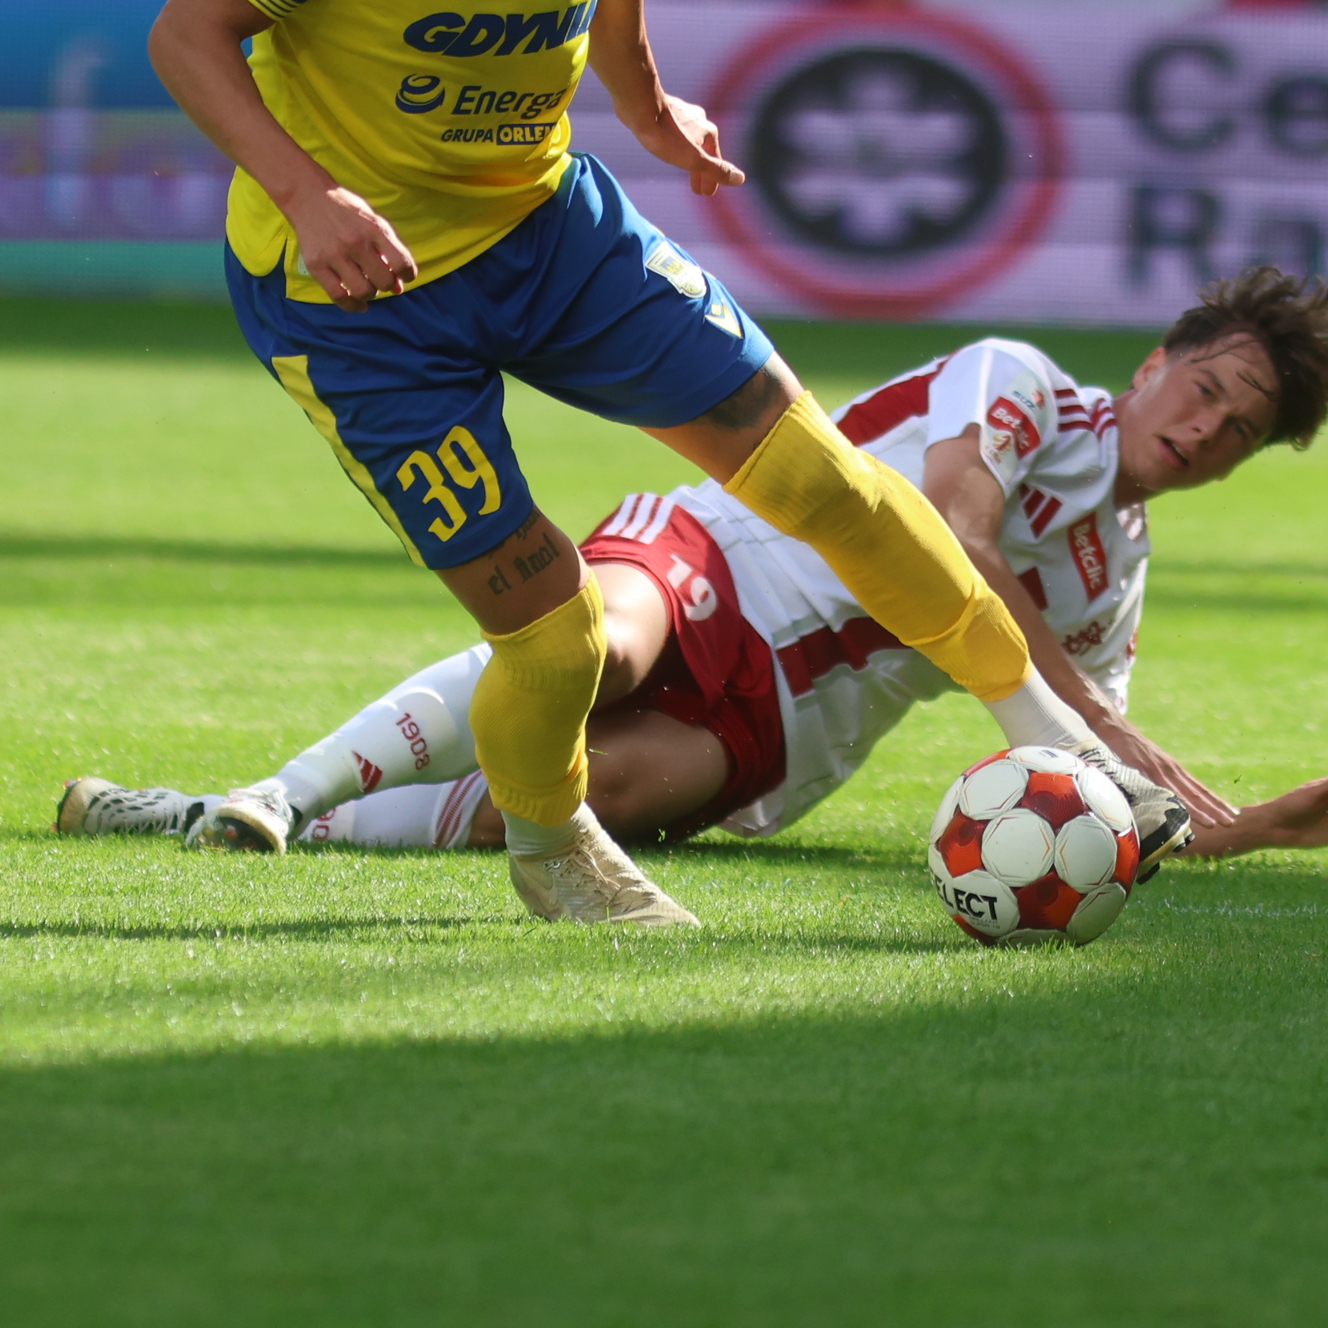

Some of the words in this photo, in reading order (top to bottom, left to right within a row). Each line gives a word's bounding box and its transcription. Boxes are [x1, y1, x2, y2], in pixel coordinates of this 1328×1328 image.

[450, 85, 568, 120] Energa
[440, 128, 494, 143] GRUPA
[395, 425, 502, 543] 39
[665, 553, 718, 622] 19
[395, 712, 432, 772] 1908
